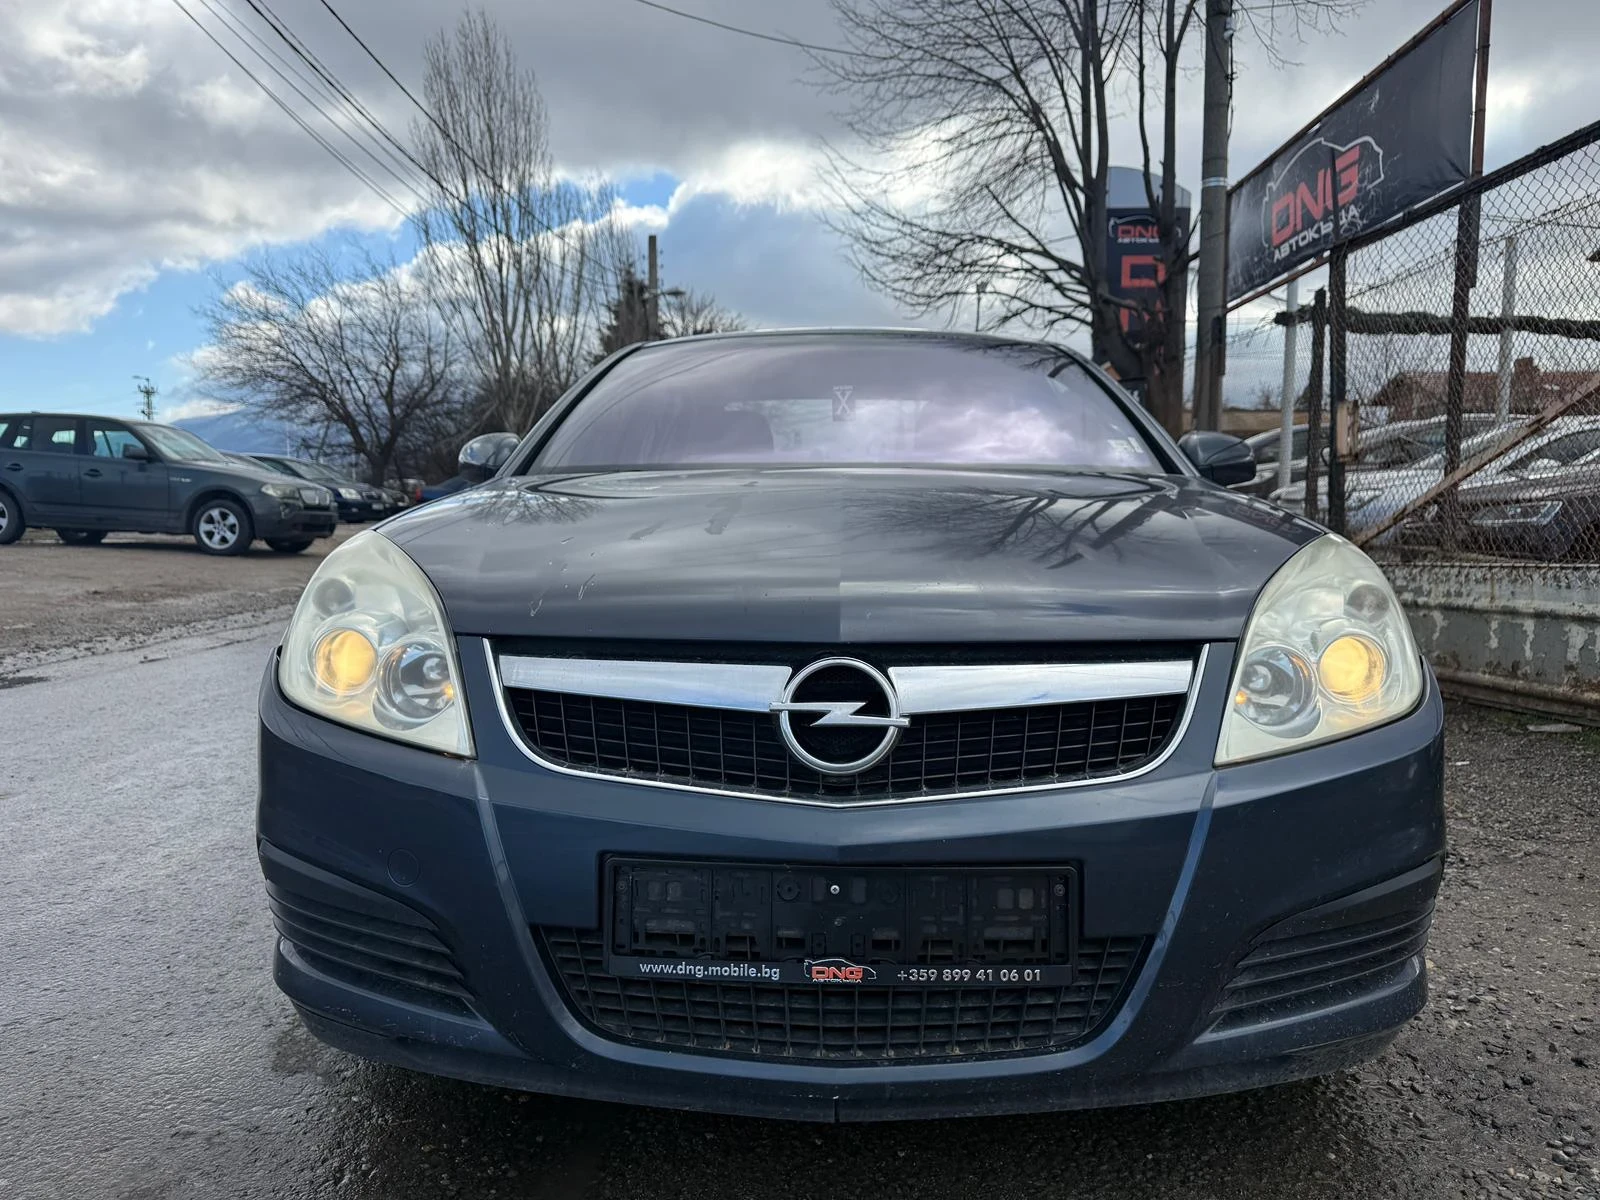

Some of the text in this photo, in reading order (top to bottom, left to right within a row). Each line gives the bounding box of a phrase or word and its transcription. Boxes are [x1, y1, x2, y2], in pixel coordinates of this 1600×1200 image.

[639, 962, 780, 980] www.dng.mobile.bg
[811, 966, 863, 979] DNG
[897, 969, 1041, 981] +359 899 41 06 01
